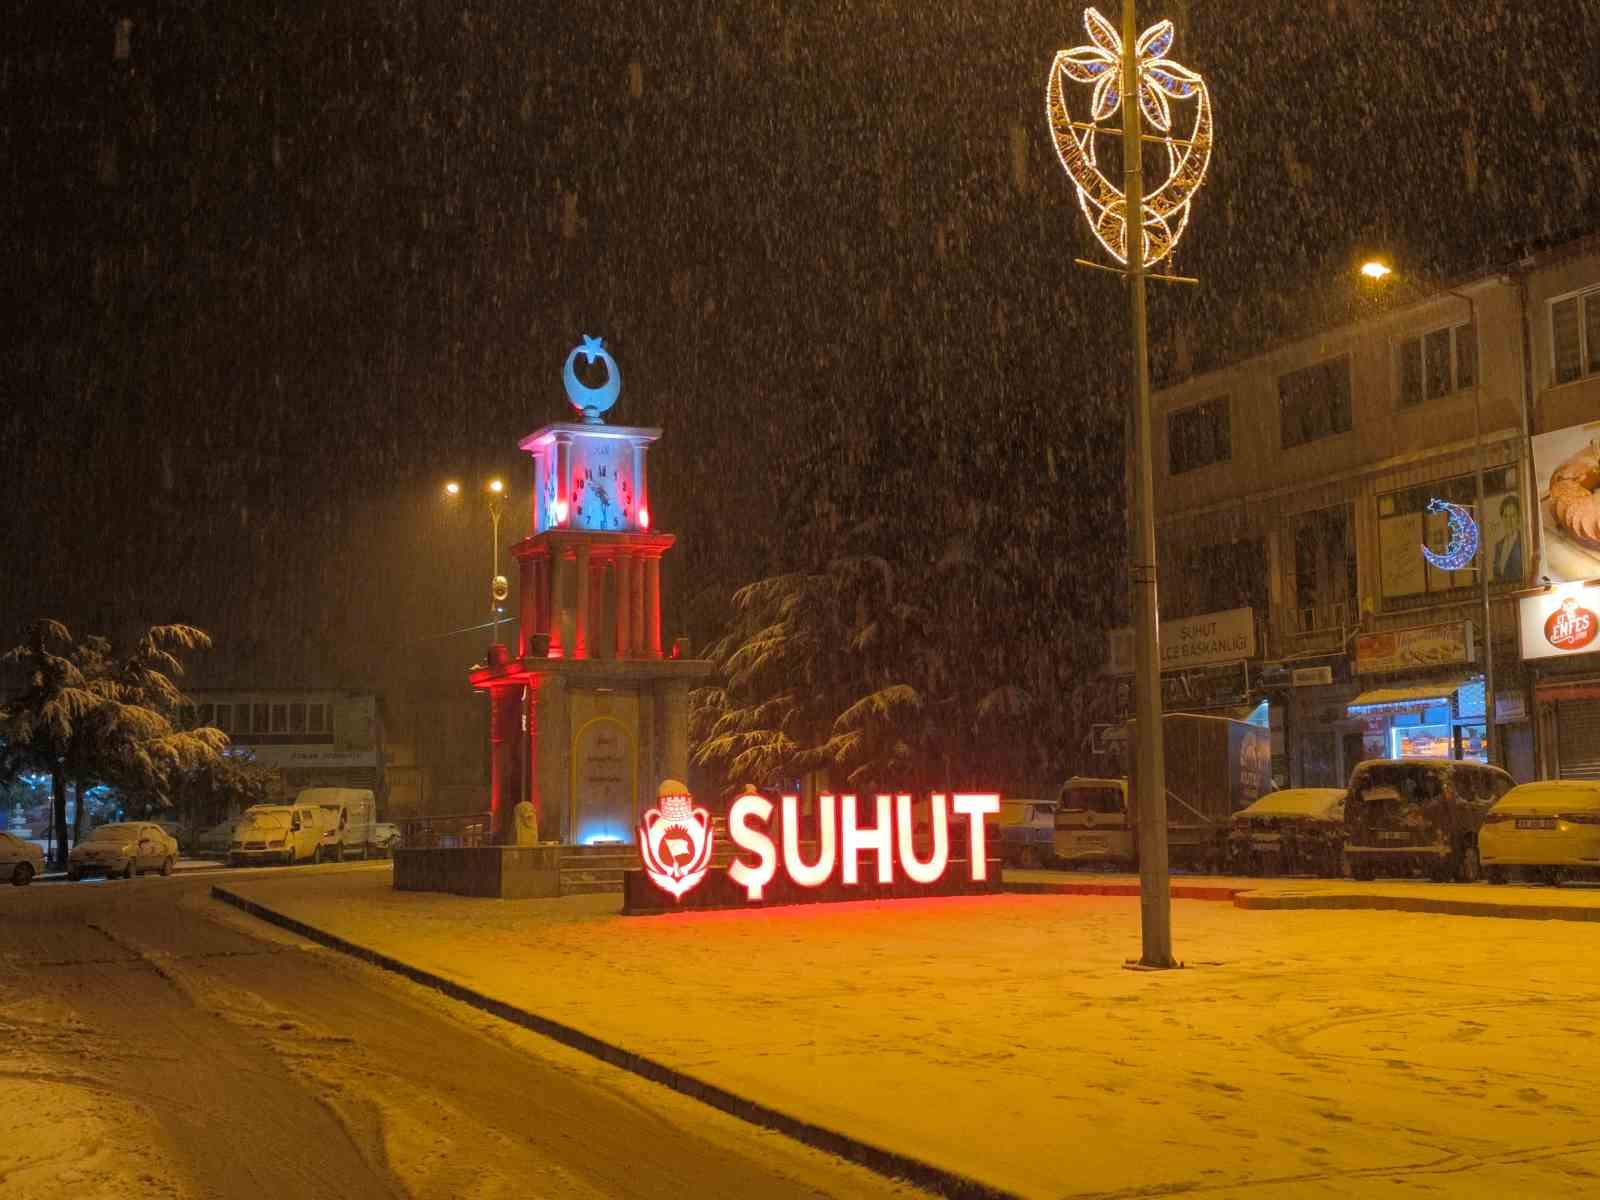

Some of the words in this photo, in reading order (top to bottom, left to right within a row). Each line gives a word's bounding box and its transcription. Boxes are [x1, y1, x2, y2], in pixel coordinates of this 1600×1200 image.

[585, 467, 593, 481] 11
[576, 479, 585, 489] 10
[584, 515, 592, 525] 7
[728, 794, 1001, 900] ŞUHUT
